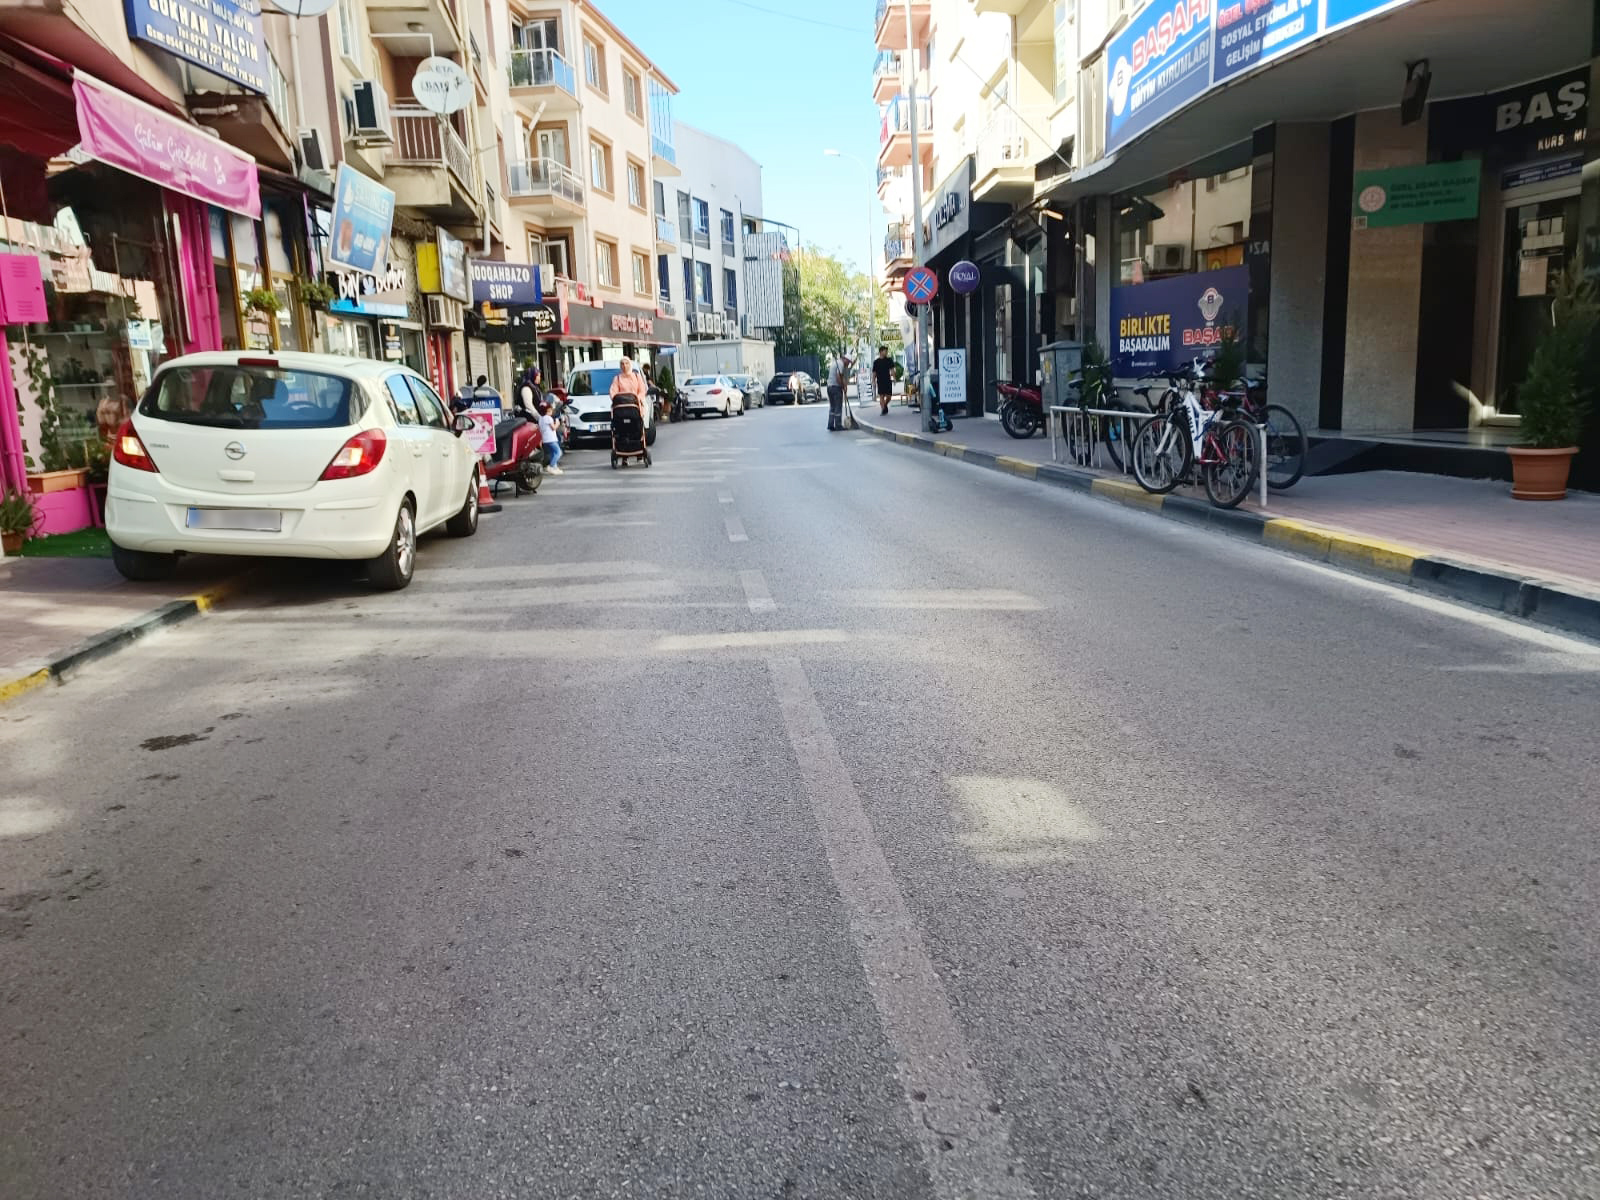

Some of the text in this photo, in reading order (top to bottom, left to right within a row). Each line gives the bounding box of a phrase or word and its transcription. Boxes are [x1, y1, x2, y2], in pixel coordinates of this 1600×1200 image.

[215, 24, 259, 62] YALÇIN
[1132, 0, 1209, 76] BAŞARI
[1222, 22, 1253, 49] SOSYAL
[1157, 37, 1210, 92] KURUMLARI
[1226, 39, 1261, 67] GELİŞİM
[1495, 80, 1588, 132] BAŞ
[1538, 134, 1564, 151] KURS
[490, 284, 513, 299] SHOP
[1120, 312, 1171, 337] BİRLİKTE
[1119, 336, 1171, 356] BAŞARALIM
